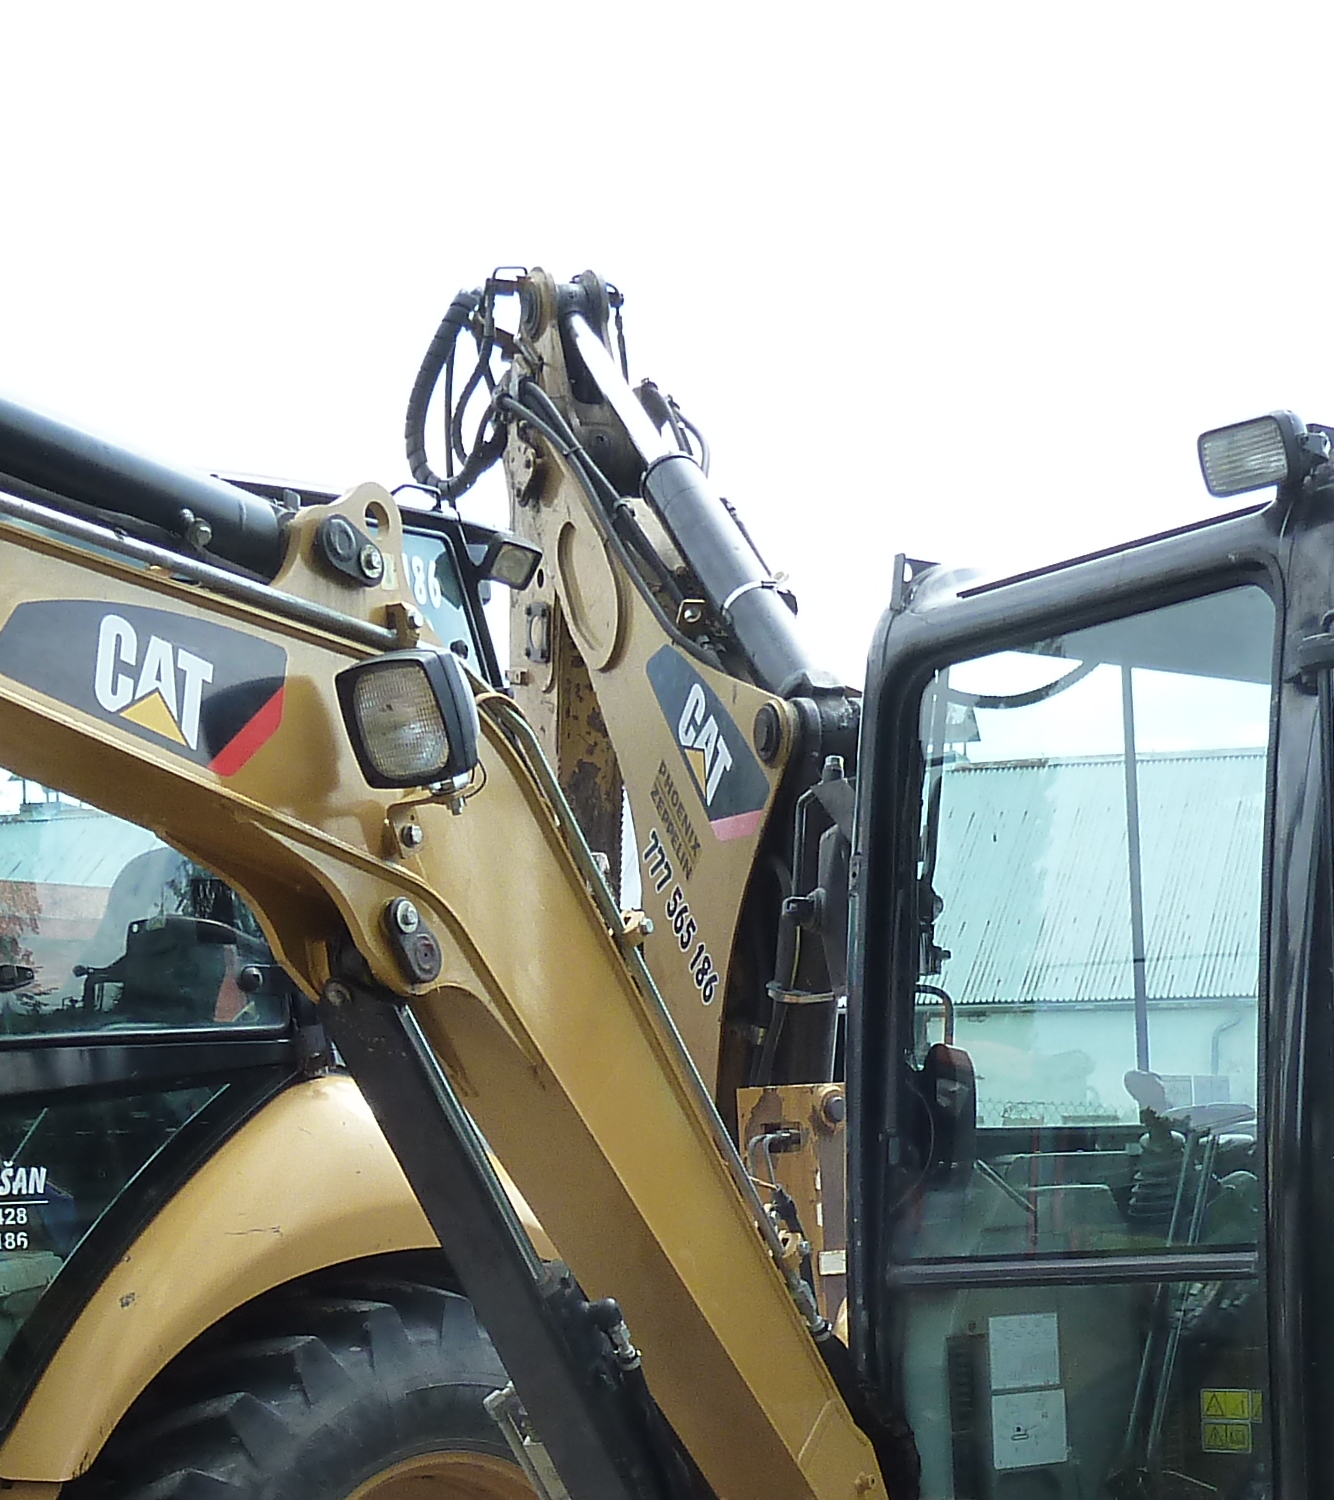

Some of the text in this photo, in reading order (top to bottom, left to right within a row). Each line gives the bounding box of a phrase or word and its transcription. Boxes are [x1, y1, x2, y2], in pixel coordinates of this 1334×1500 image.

[94, 614, 214, 750] CAT
[677, 682, 733, 807] CAT
[650, 787, 693, 881] ZEPPELIN
[658, 759, 701, 858] PHOENIX
[643, 828, 719, 1005] 777 565 186
